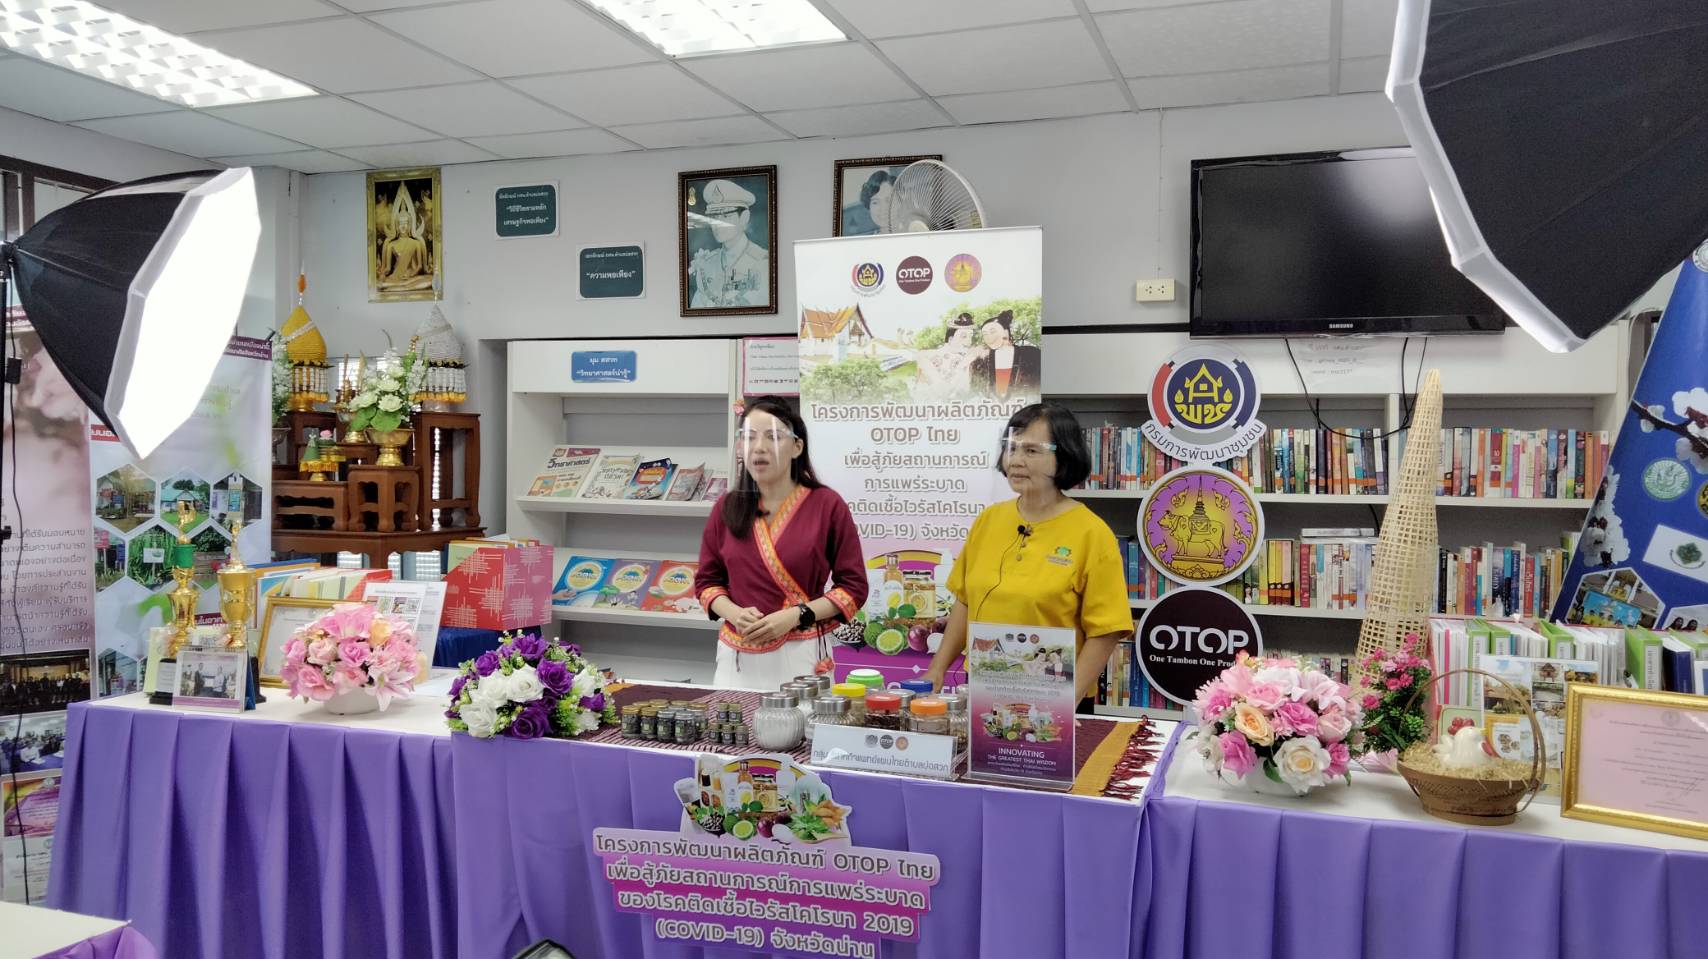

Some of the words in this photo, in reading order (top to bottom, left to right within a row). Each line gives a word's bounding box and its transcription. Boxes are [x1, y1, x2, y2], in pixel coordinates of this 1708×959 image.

[898, 267, 930, 279] OTOP
[871, 427, 920, 442] OTOP
[927, 426, 958, 442] ไทย
[1144, 423, 1263, 462] กรมการพัฒนาชุมชน
[844, 448, 987, 472] เพื่อสู้ภัยสถานการณ์
[864, 476, 965, 490] การแพร่ระบาด
[1149, 624, 1249, 655] OTOP
[1149, 654, 1165, 663] One
[1167, 655, 1198, 665] Tambon
[1200, 658, 1215, 666] One
[1217, 659, 1236, 667] Prod
[998, 747, 1045, 759] INNOVATING
[596, 834, 825, 867] โครงการพัฒนาผลิตภัณฑ์
[833, 853, 890, 873] OTOP
[897, 859, 934, 880] ไทย
[608, 858, 924, 908] เพื่อสู้ภัยสถานการณ์การแพร่ระบาด
[619, 890, 856, 928] ของโรคติดเชื้อไวรัสโคโรนา
[865, 914, 913, 934] 2019
[772, 928, 875, 958] จังหวัดน่าน
